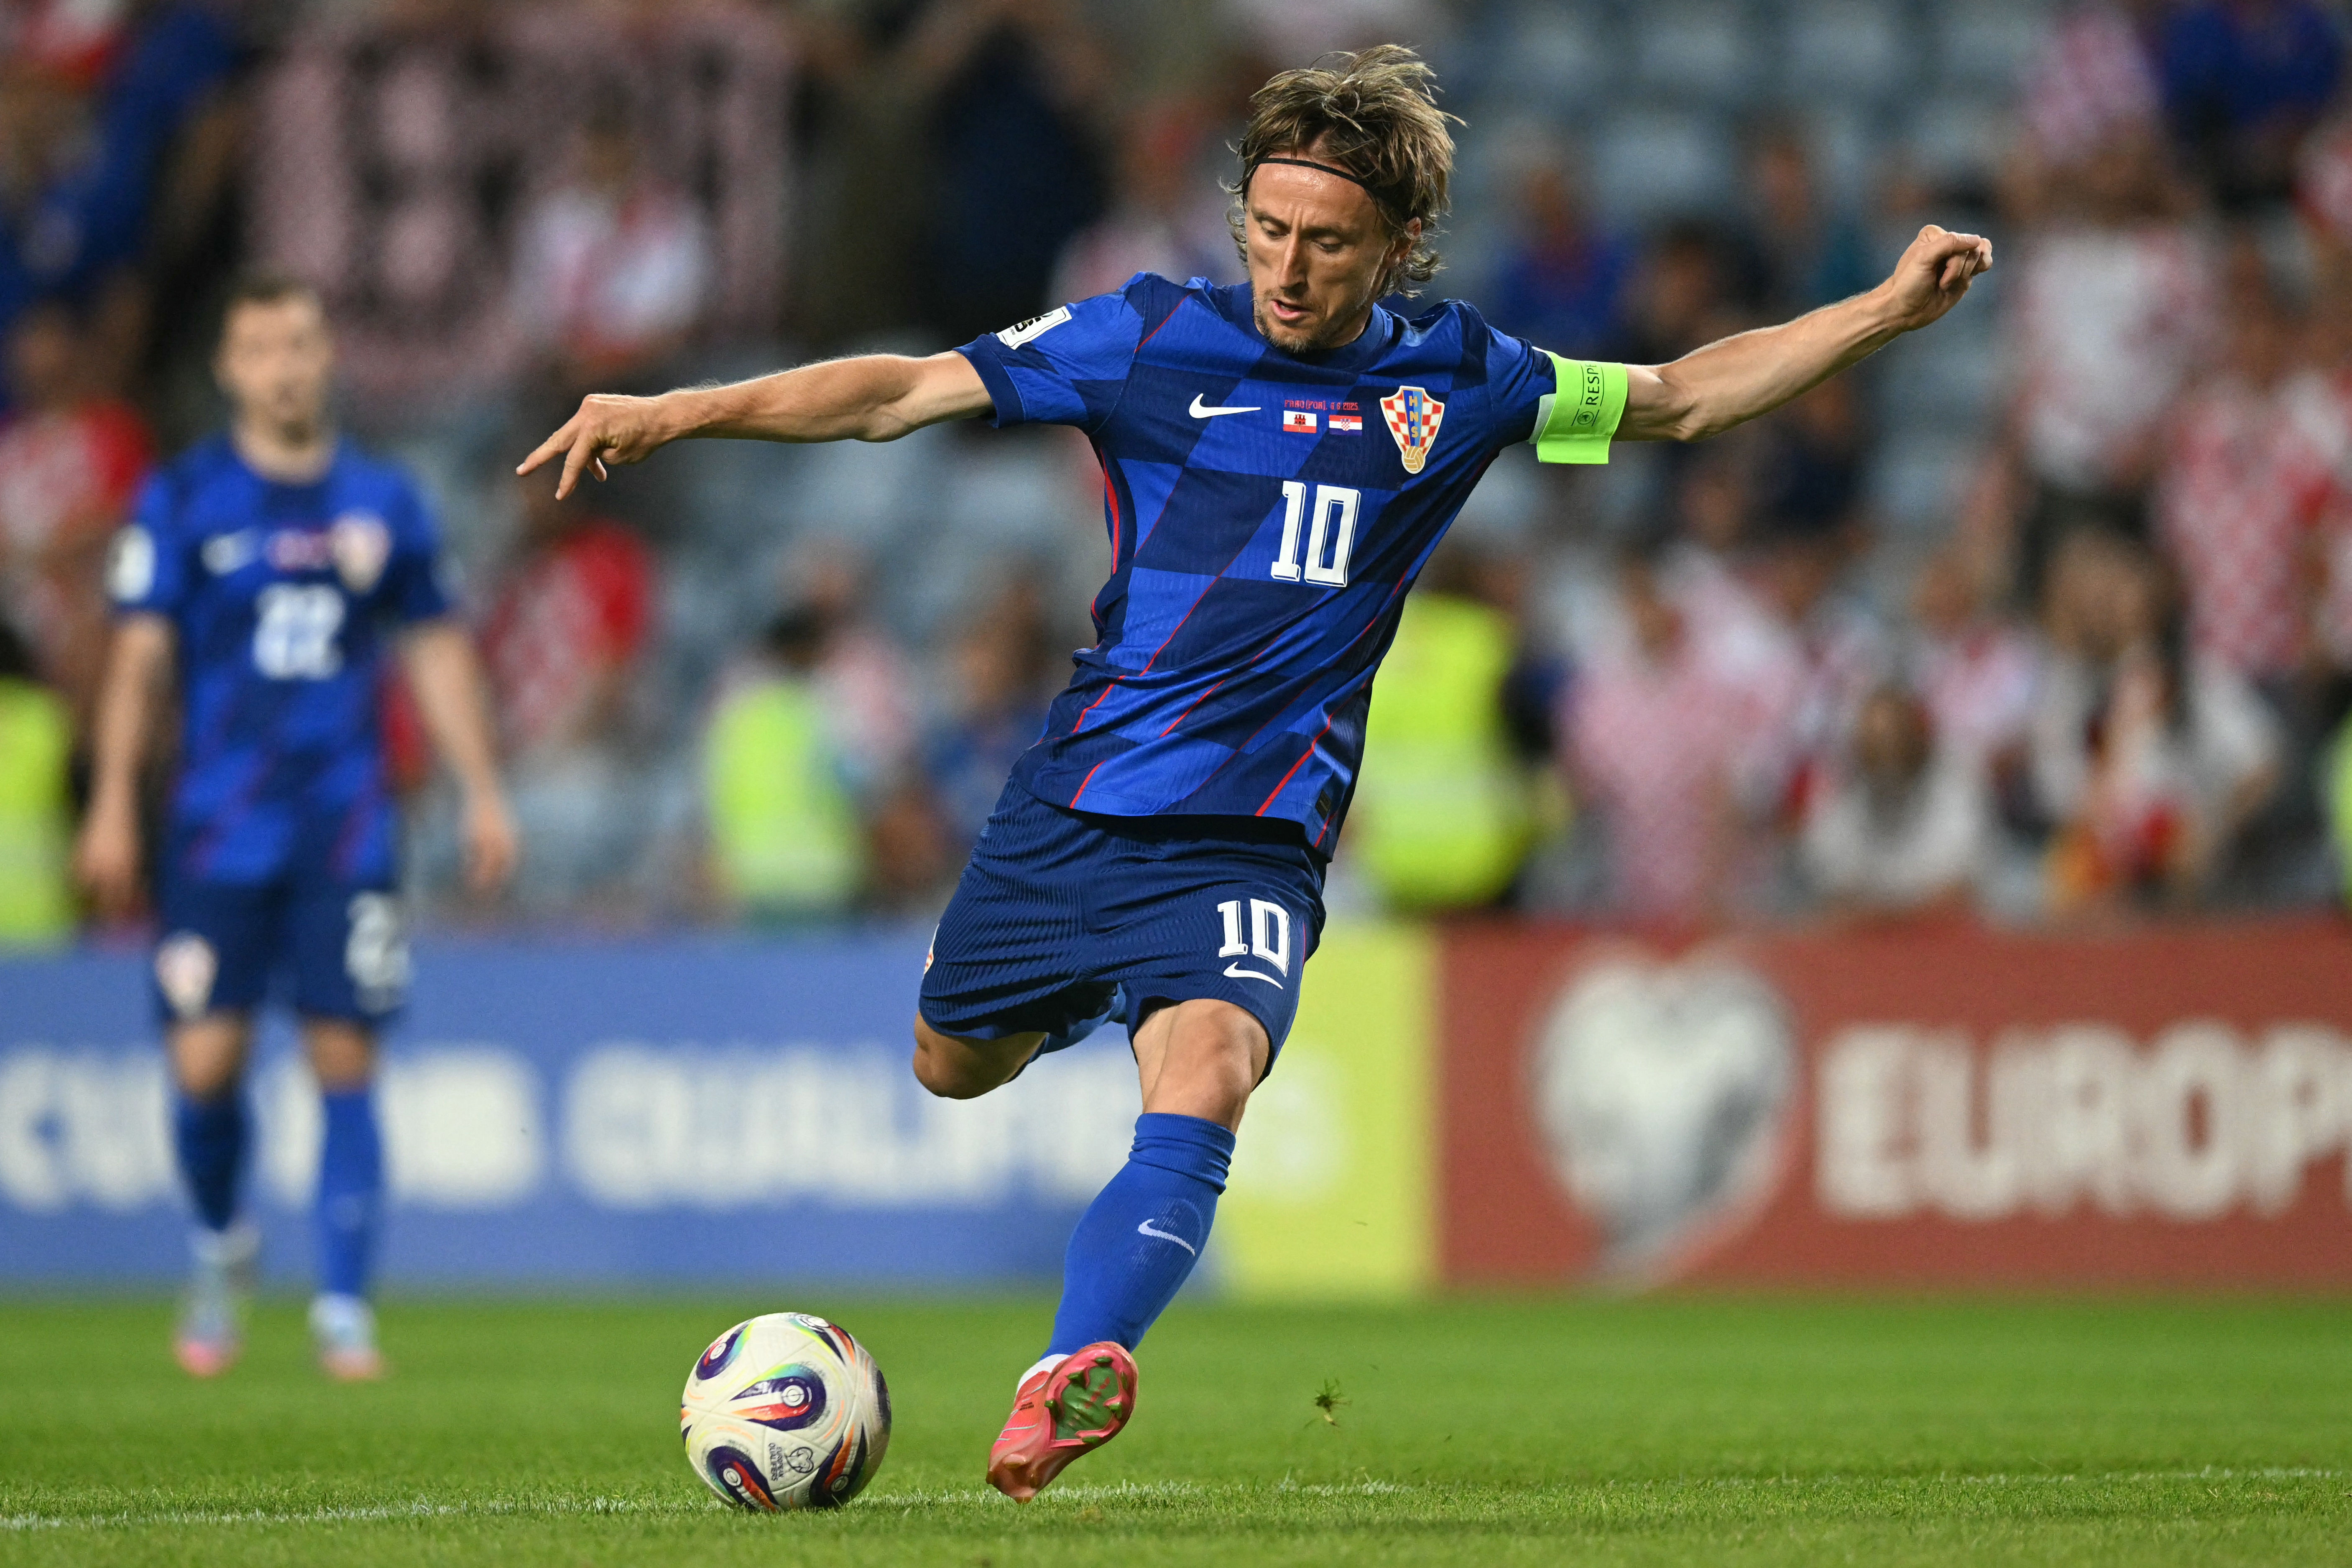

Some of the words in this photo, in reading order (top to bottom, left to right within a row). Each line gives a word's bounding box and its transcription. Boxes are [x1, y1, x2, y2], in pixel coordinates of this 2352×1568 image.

[1284, 400, 1305, 409] FARO
[1408, 395, 1419, 438] HNS
[1271, 480, 1361, 587] 10
[1217, 898, 1290, 978] 10
[1817, 1020, 2352, 1221] EUROP
